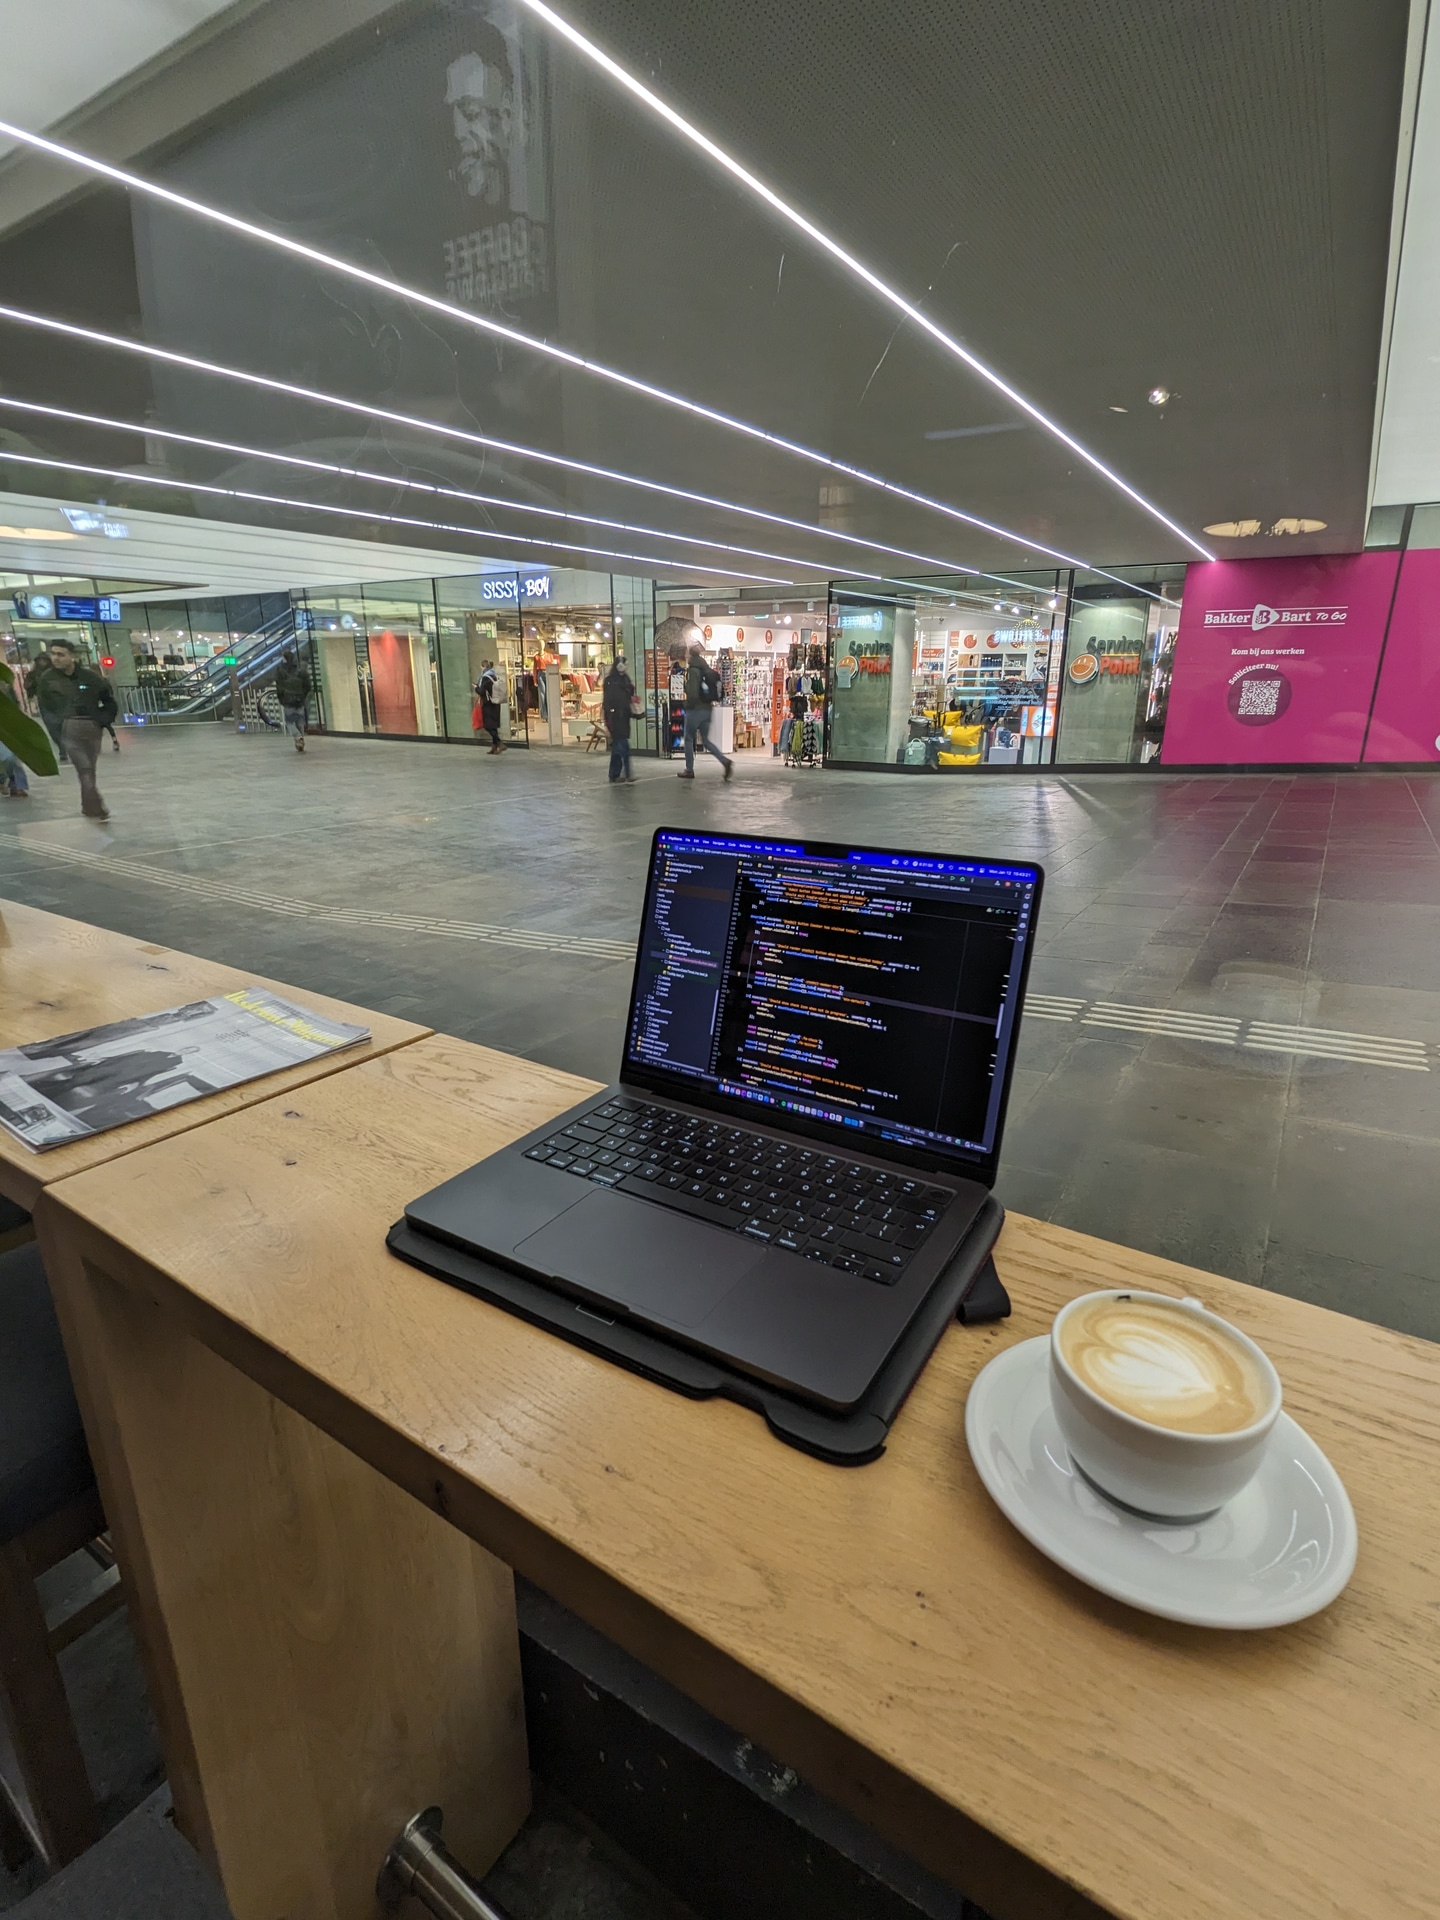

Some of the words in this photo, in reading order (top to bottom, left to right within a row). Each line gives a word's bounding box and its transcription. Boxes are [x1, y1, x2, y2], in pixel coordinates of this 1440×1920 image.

[1204, 613, 1251, 625] Bakker
[1281, 611, 1311, 623] Bart
[848, 639, 893, 657] Service
[1086, 635, 1144, 654] Service
[1231, 648, 1248, 656] Kom
[1249, 647, 1260, 657] bij
[1275, 648, 1305, 656] werken
[859, 657, 891, 675] Point
[1099, 656, 1140, 676] Point
[1228, 663, 1265, 686] Solliciteer
[1265, 663, 1280, 671] nu!
[550, 1158, 566, 1166] control
[593, 1173, 614, 1182] command
[745, 1226, 770, 1238] command
[779, 1238, 797, 1247] option
